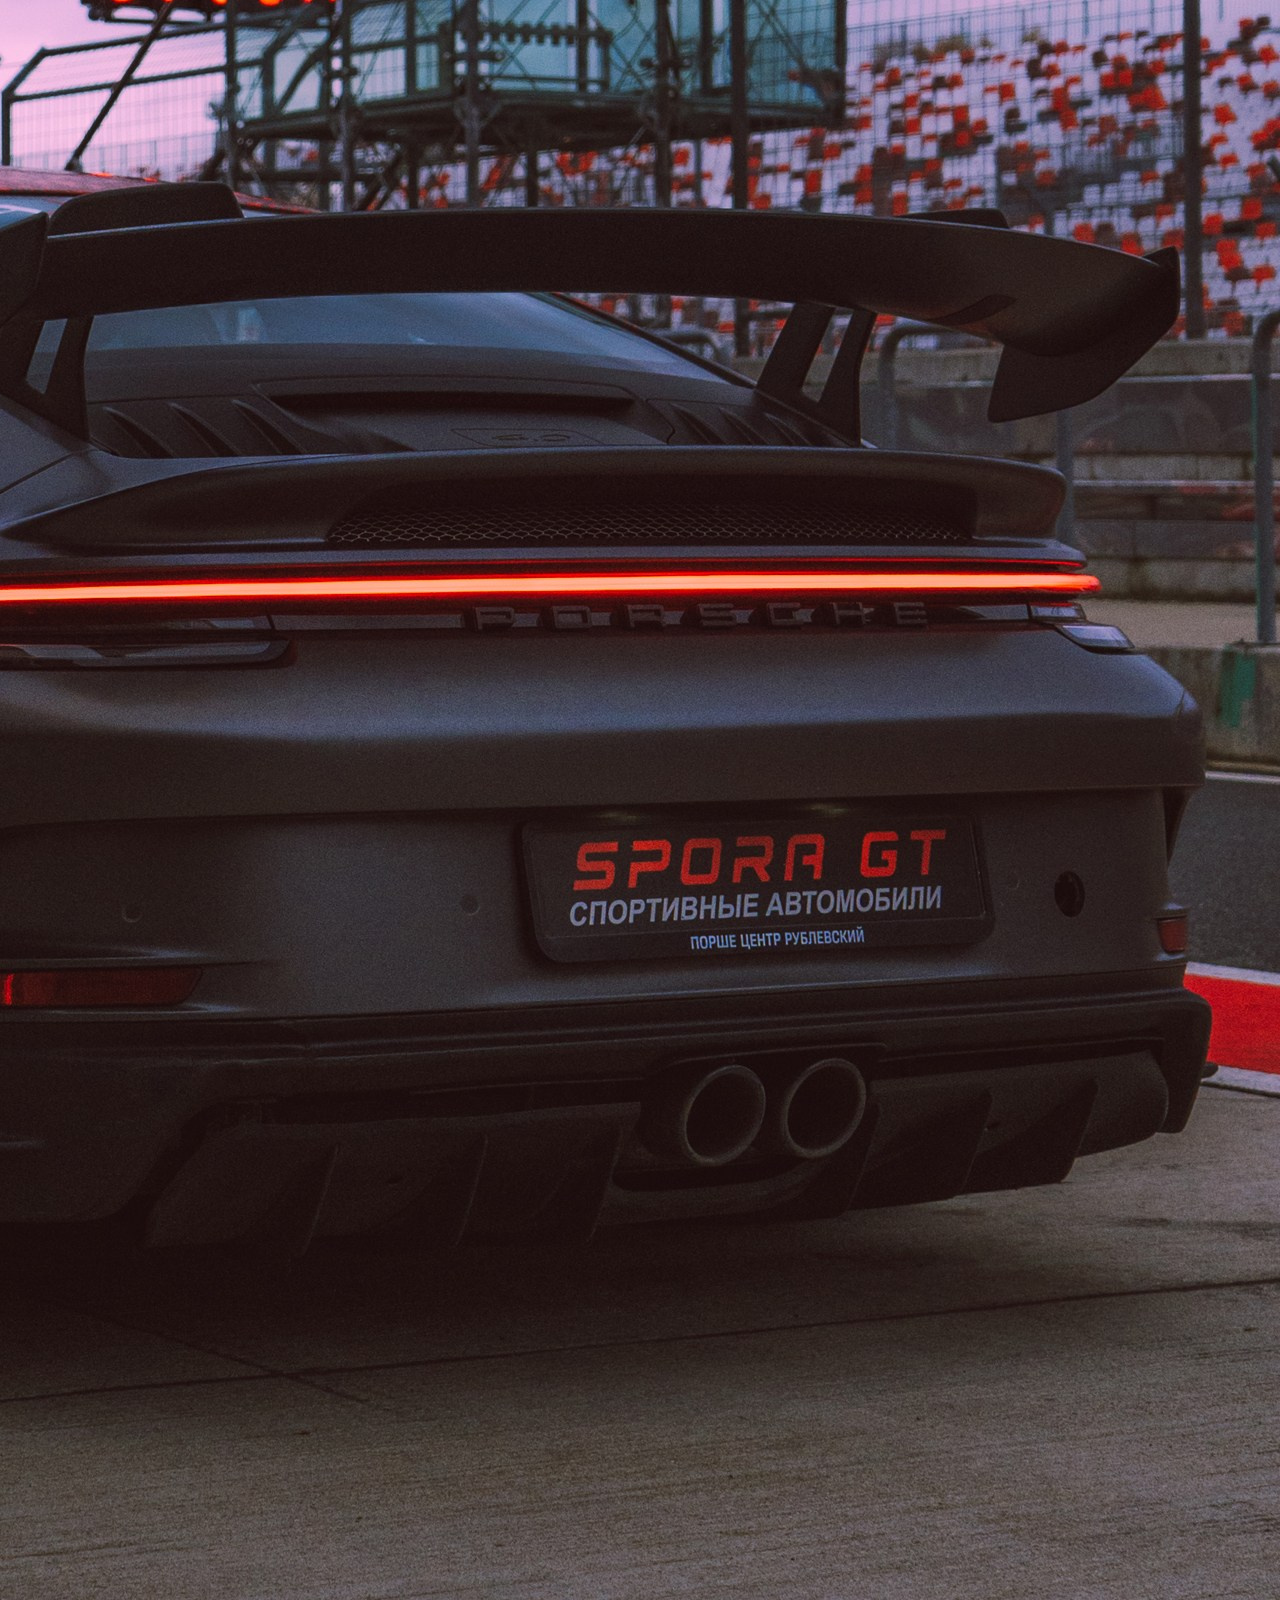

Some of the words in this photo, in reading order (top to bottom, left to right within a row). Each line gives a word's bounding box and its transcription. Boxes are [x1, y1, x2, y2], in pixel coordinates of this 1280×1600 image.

[474, 601, 928, 631] PORSCHE
[572, 833, 826, 891] SPORA
[860, 828, 948, 879] GT
[569, 893, 760, 927] СПОРТИВНЫЕ
[765, 885, 943, 918] АВТОМОБИЛИ
[690, 934, 737, 950] ПОРШЕ
[741, 930, 781, 950] ЦЕНТР
[785, 926, 865, 947] РУБЛЕВСКИЙ
